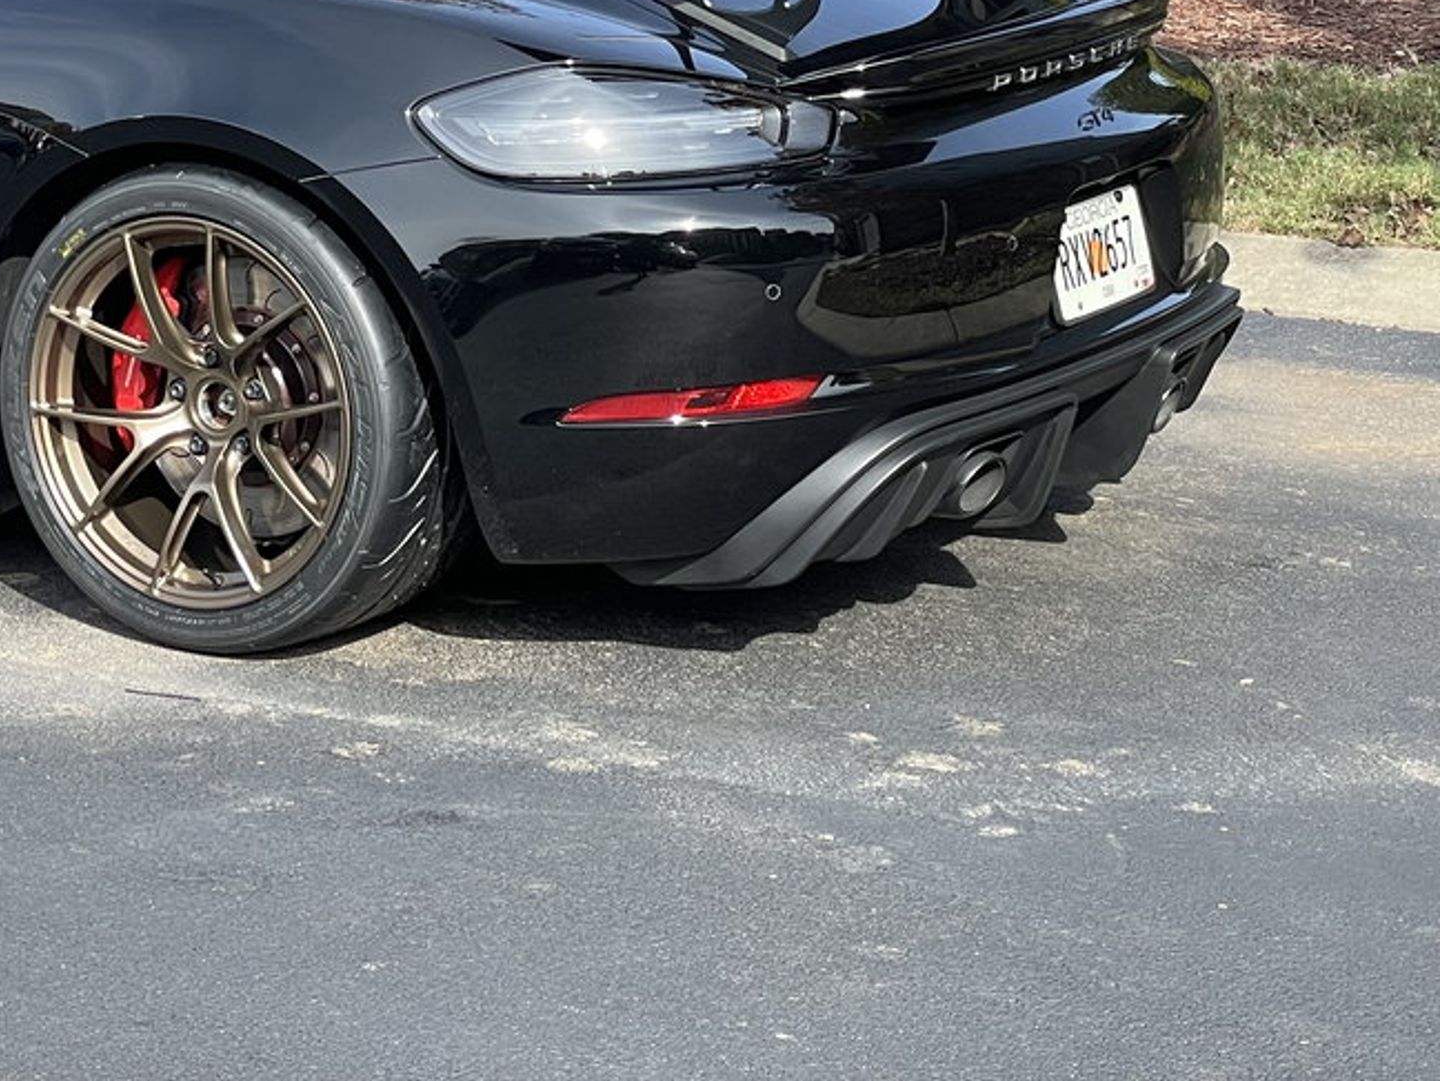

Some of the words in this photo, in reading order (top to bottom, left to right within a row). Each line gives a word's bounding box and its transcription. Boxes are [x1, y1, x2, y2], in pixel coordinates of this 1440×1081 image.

[986, 35, 1139, 91] PORSCHE
[1077, 106, 1114, 131] GT4
[1059, 215, 1136, 292] RXV2657
